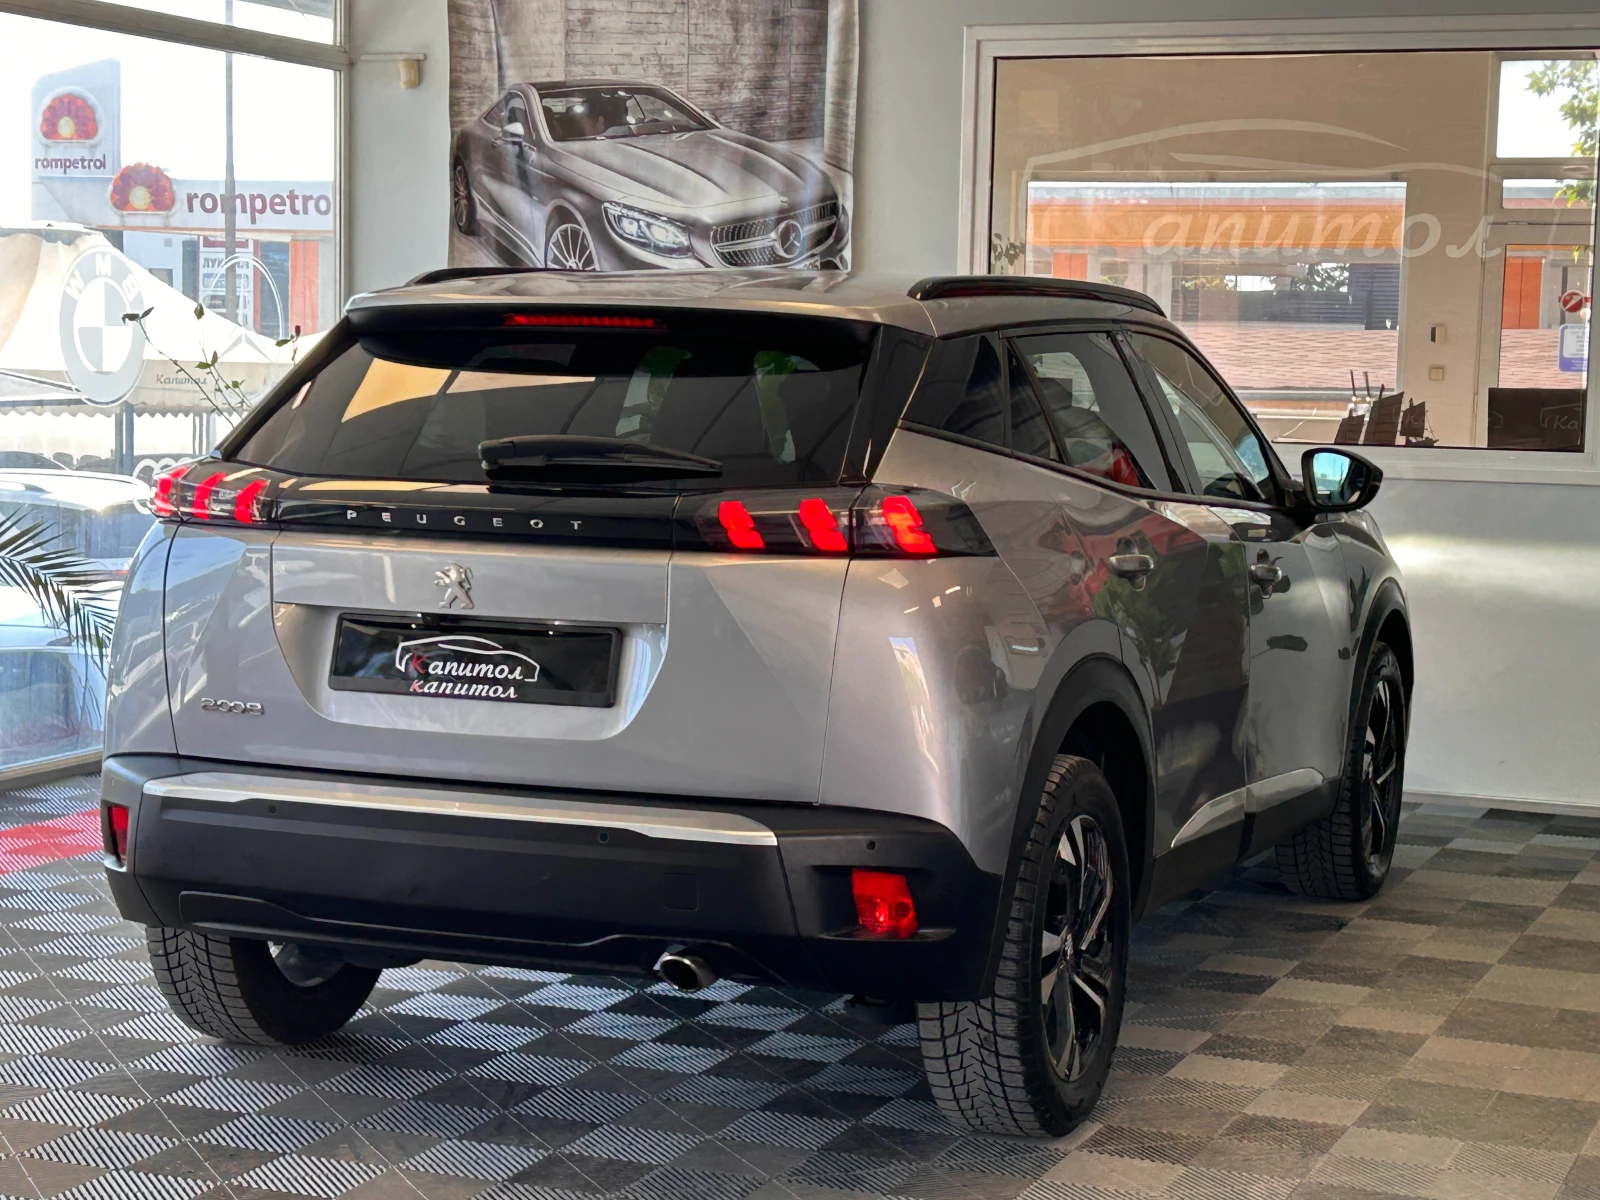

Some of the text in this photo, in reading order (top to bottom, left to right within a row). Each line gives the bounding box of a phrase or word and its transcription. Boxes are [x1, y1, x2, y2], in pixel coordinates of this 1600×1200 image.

[35, 153, 107, 175] rompetrol
[1086, 210, 1503, 259] апитол
[346, 509, 582, 530] PEUGEOT
[201, 697, 264, 716] 2008
